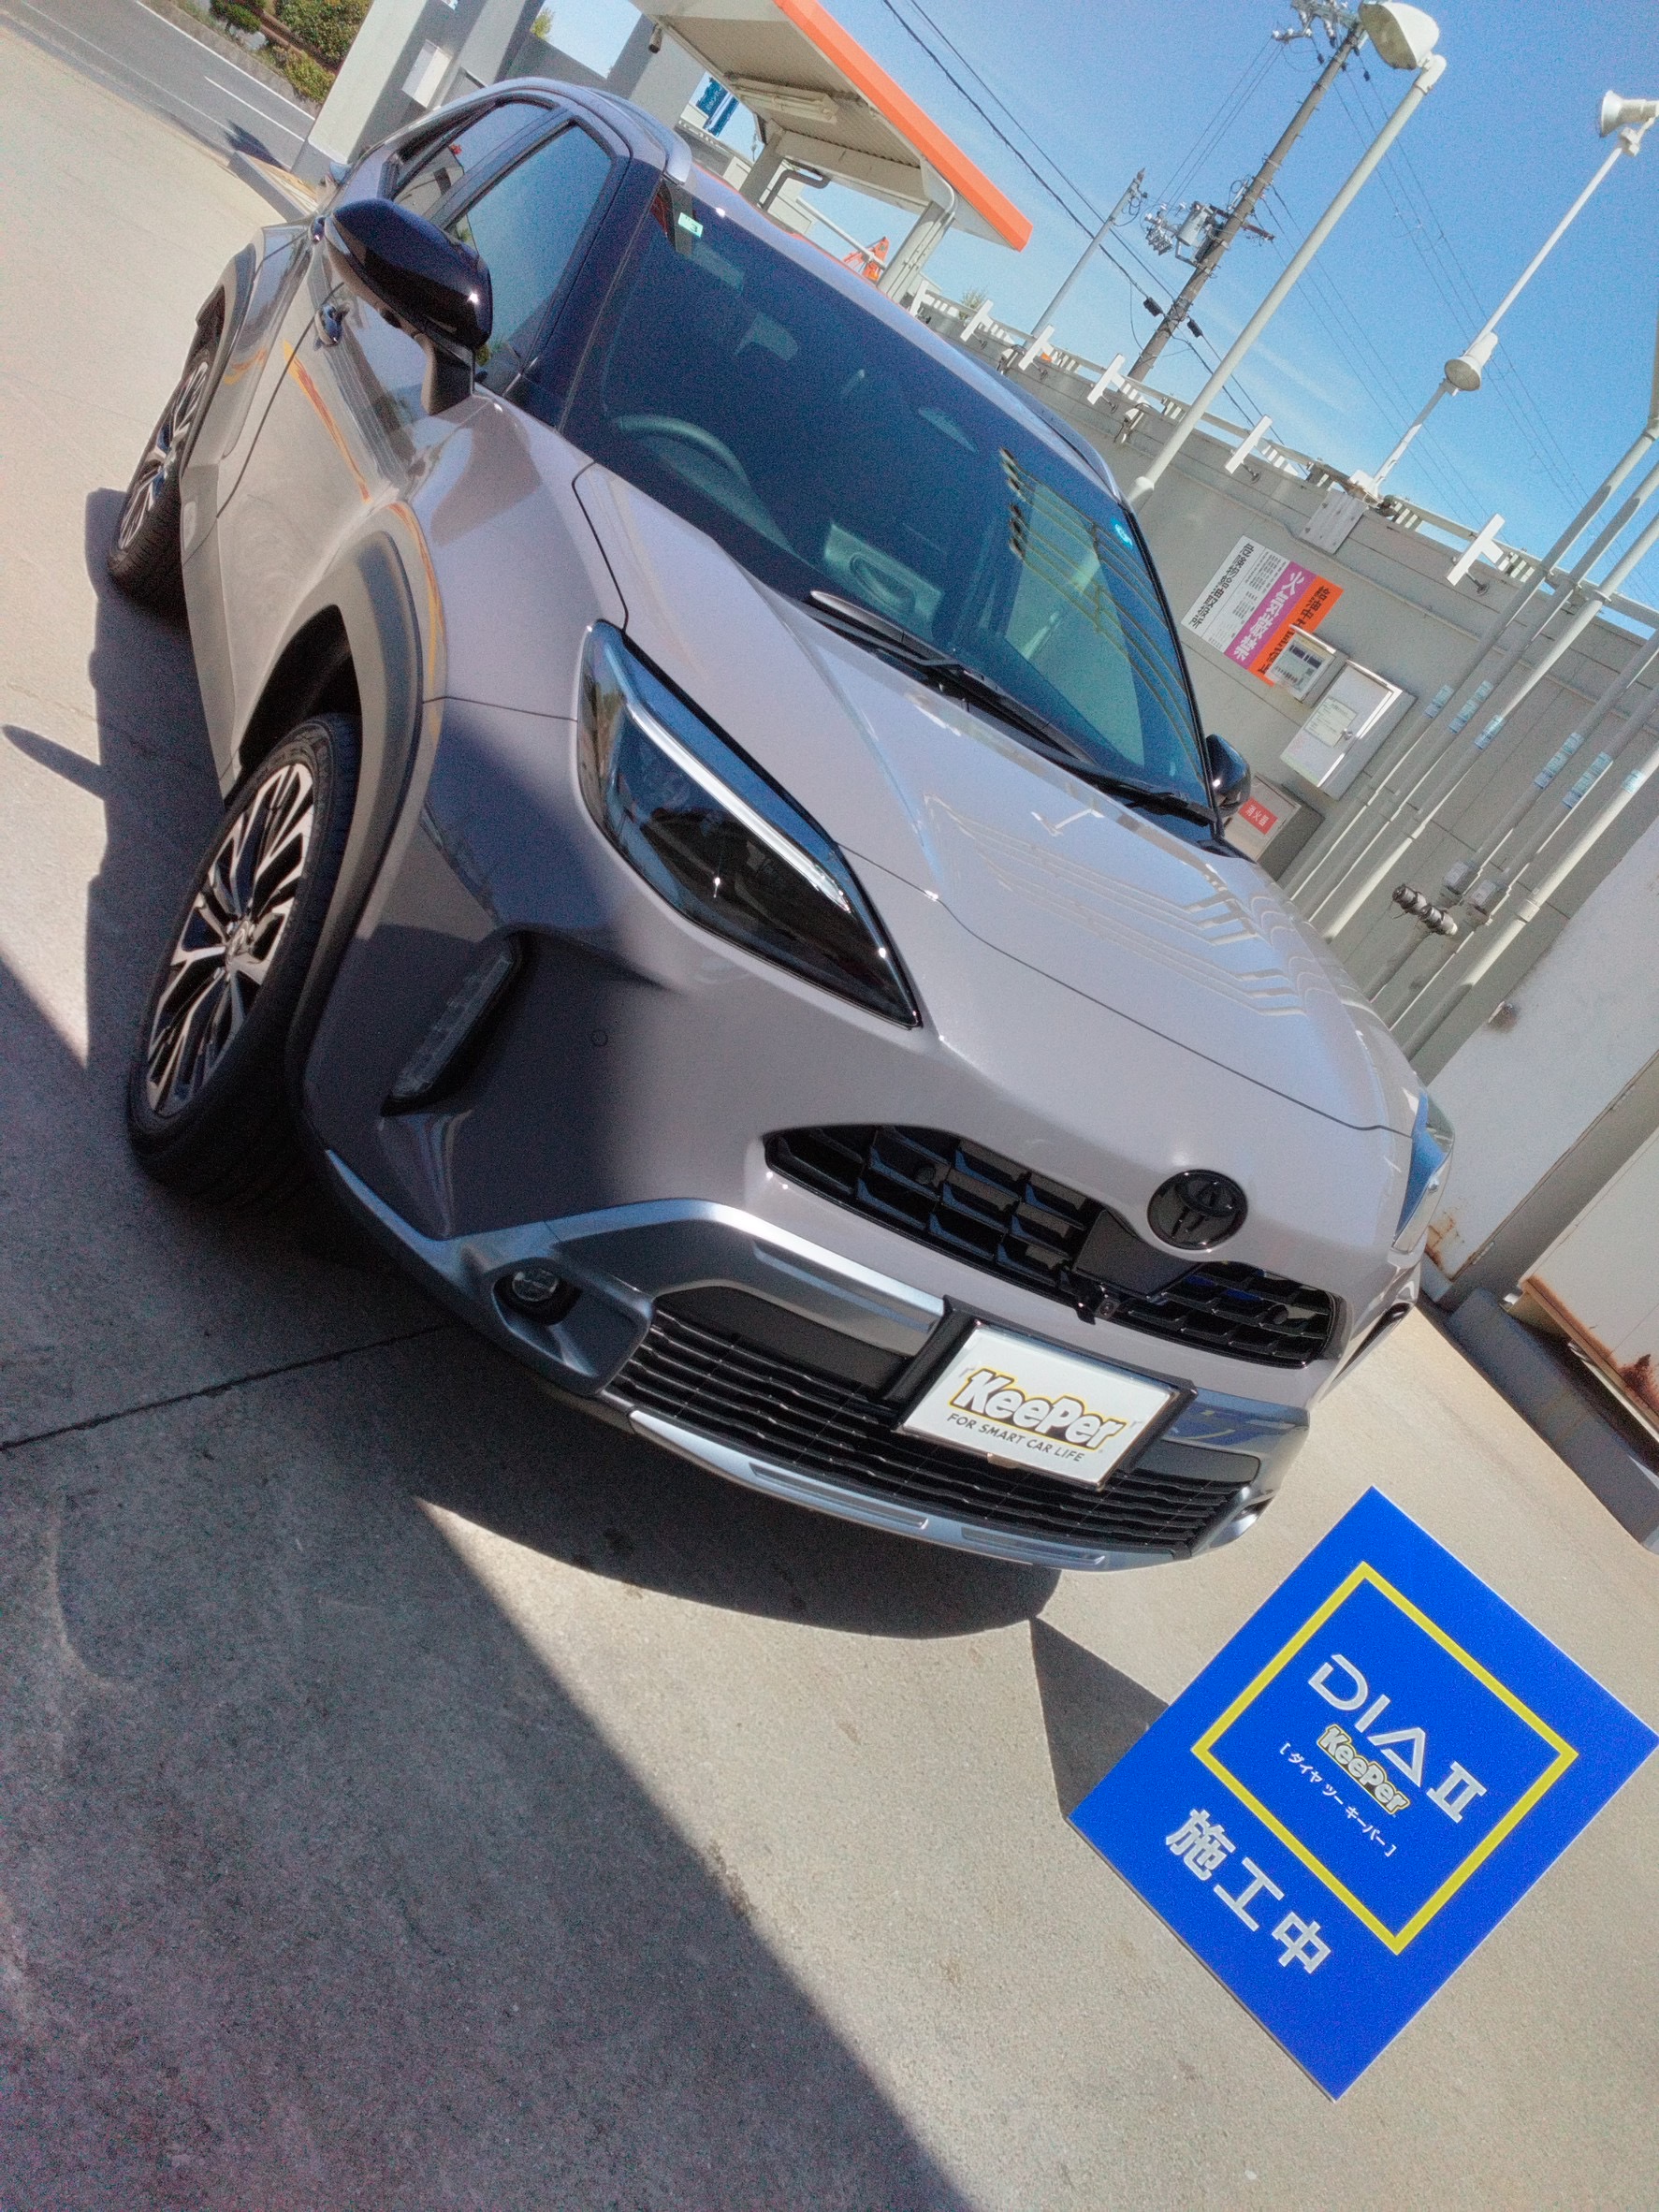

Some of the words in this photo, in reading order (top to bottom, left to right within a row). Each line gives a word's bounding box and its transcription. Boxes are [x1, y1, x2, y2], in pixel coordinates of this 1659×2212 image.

[1188, 543, 1255, 630] 危険物給油取扱所
[1233, 570, 1305, 662] 火気厳禁
[947, 1412, 978, 1430] FOR
[978, 1423, 1026, 1445] SMART
[1026, 1438, 1054, 1454] CAR
[1054, 1446, 1085, 1463] LIFE
[949, 1367, 1128, 1451] KeePer
[1307, 1653, 1427, 1788] DIA
[1316, 1724, 1411, 1815] KeePer
[1165, 1808, 1332, 1974] 施工中
